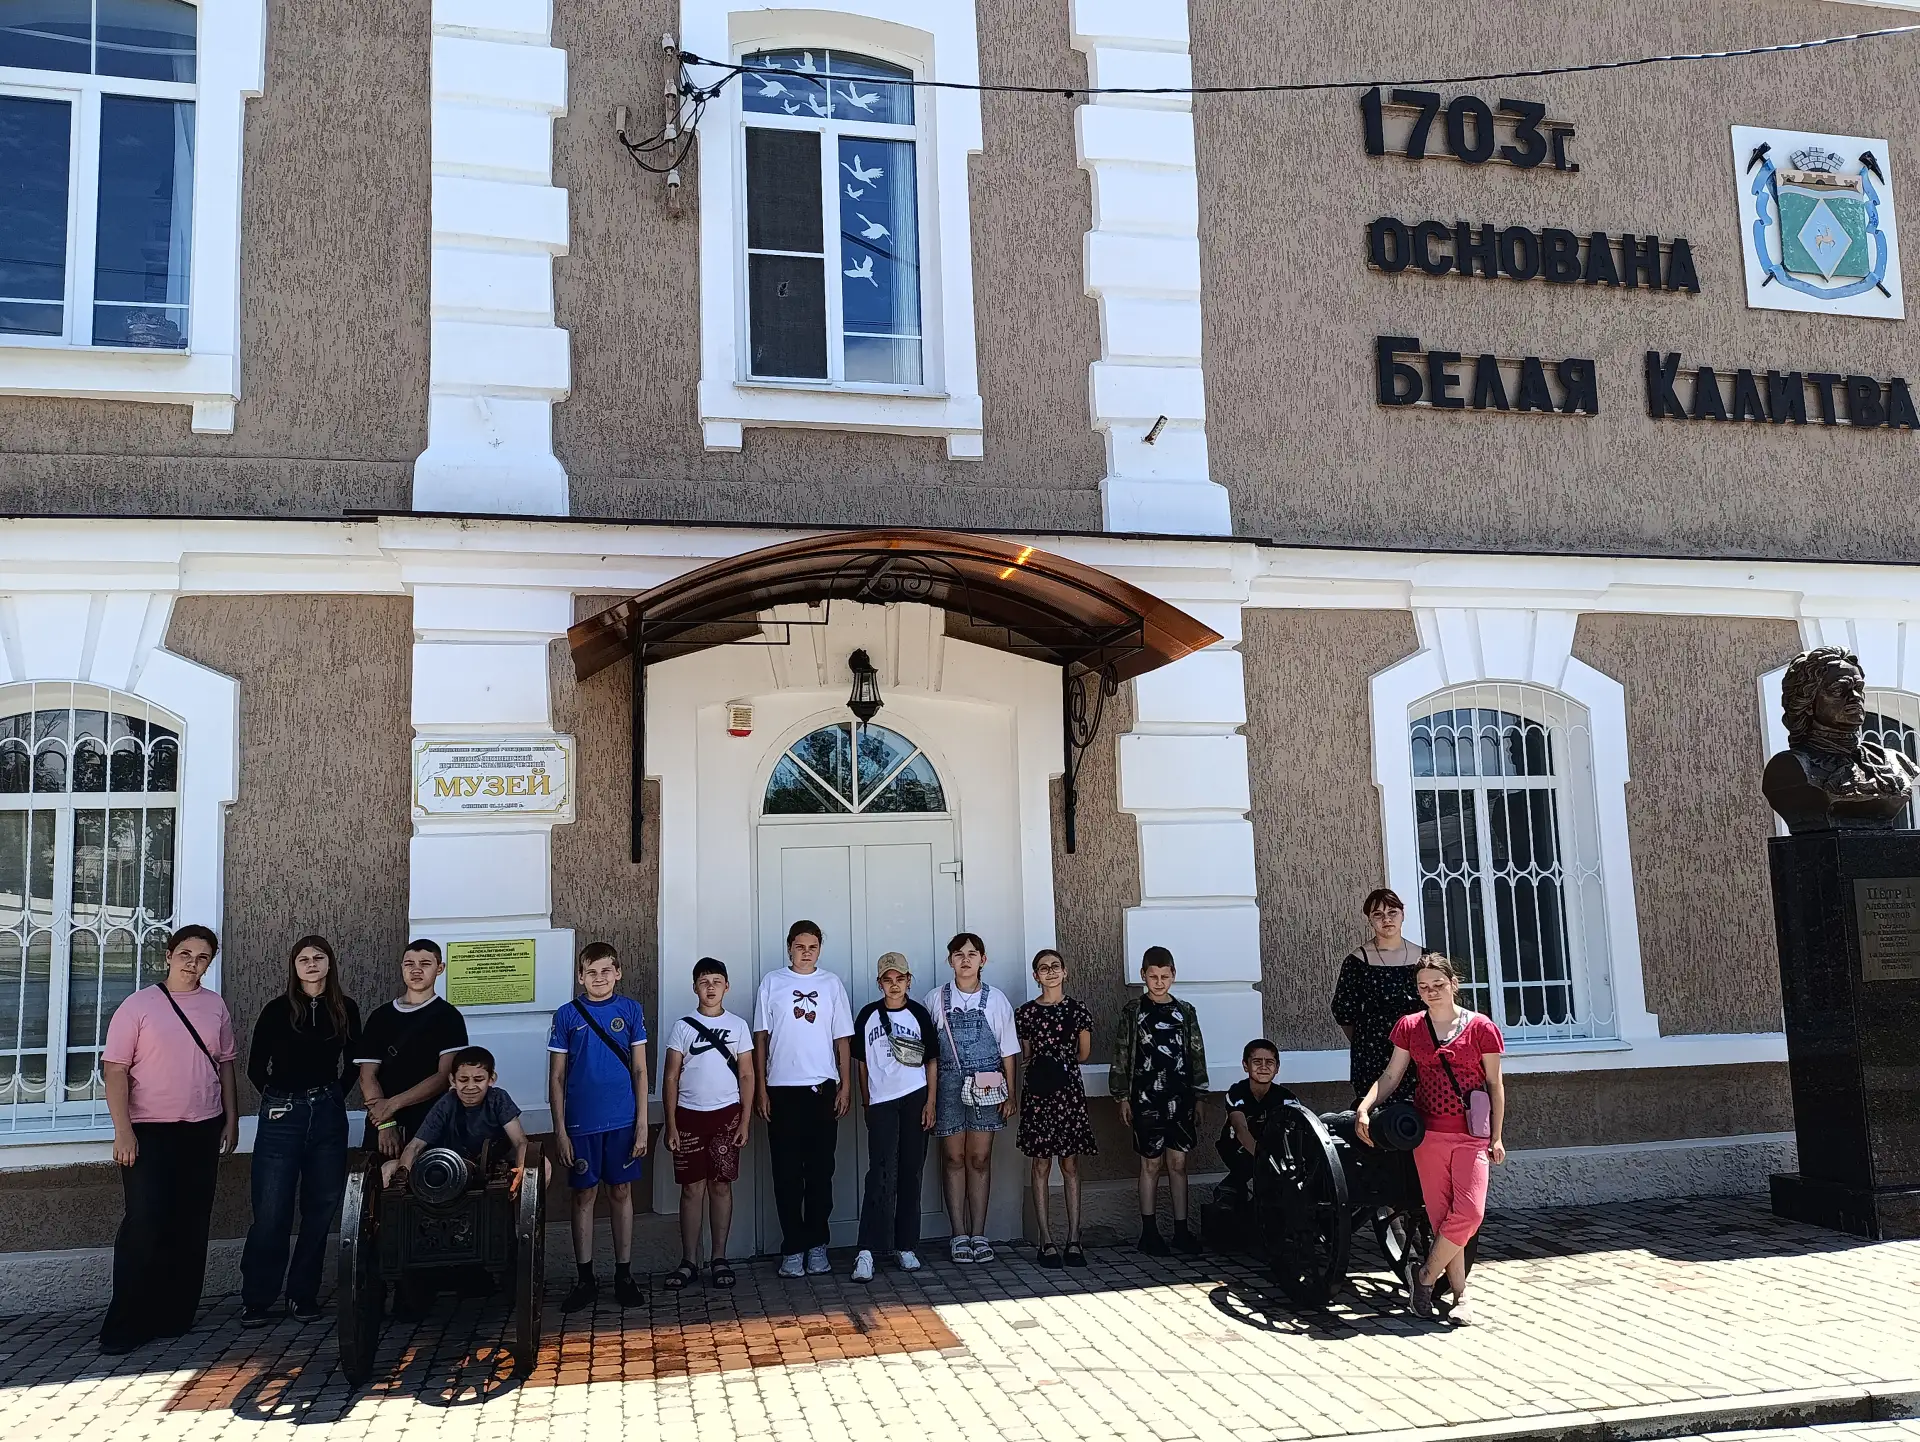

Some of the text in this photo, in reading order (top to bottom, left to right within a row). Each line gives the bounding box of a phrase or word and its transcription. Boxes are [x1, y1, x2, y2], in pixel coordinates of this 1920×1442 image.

[1369, 216, 1700, 293] ОСНОВАНА
[1377, 335, 1920, 429] БЕЛАЯ КАЛИТВА
[434, 768, 551, 797] МУЗЕЙ
